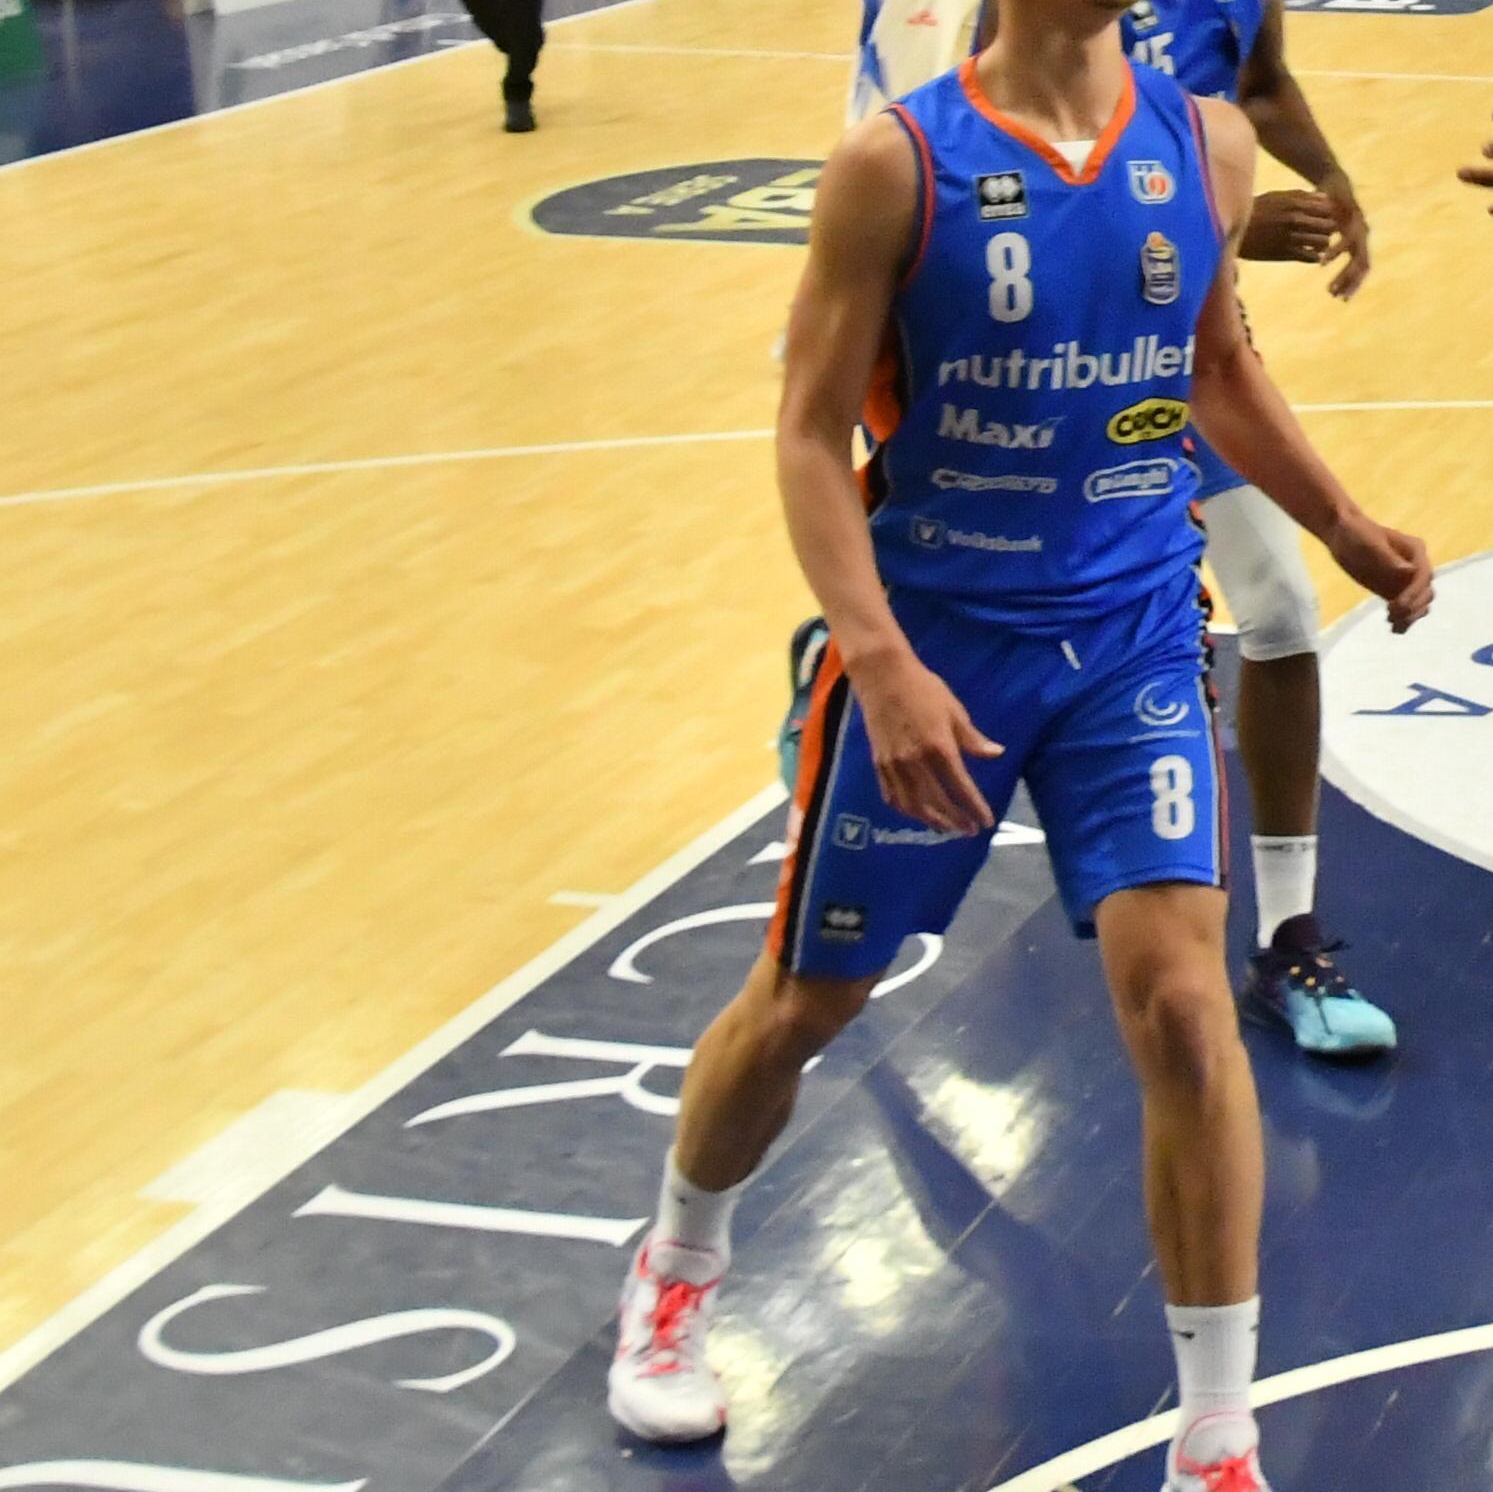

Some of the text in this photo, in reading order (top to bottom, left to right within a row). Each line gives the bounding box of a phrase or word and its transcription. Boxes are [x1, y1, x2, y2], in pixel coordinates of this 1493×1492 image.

[985, 231, 1034, 323] 8
[937, 334, 1196, 391] nutribullet
[1148, 754, 1195, 842] 8
